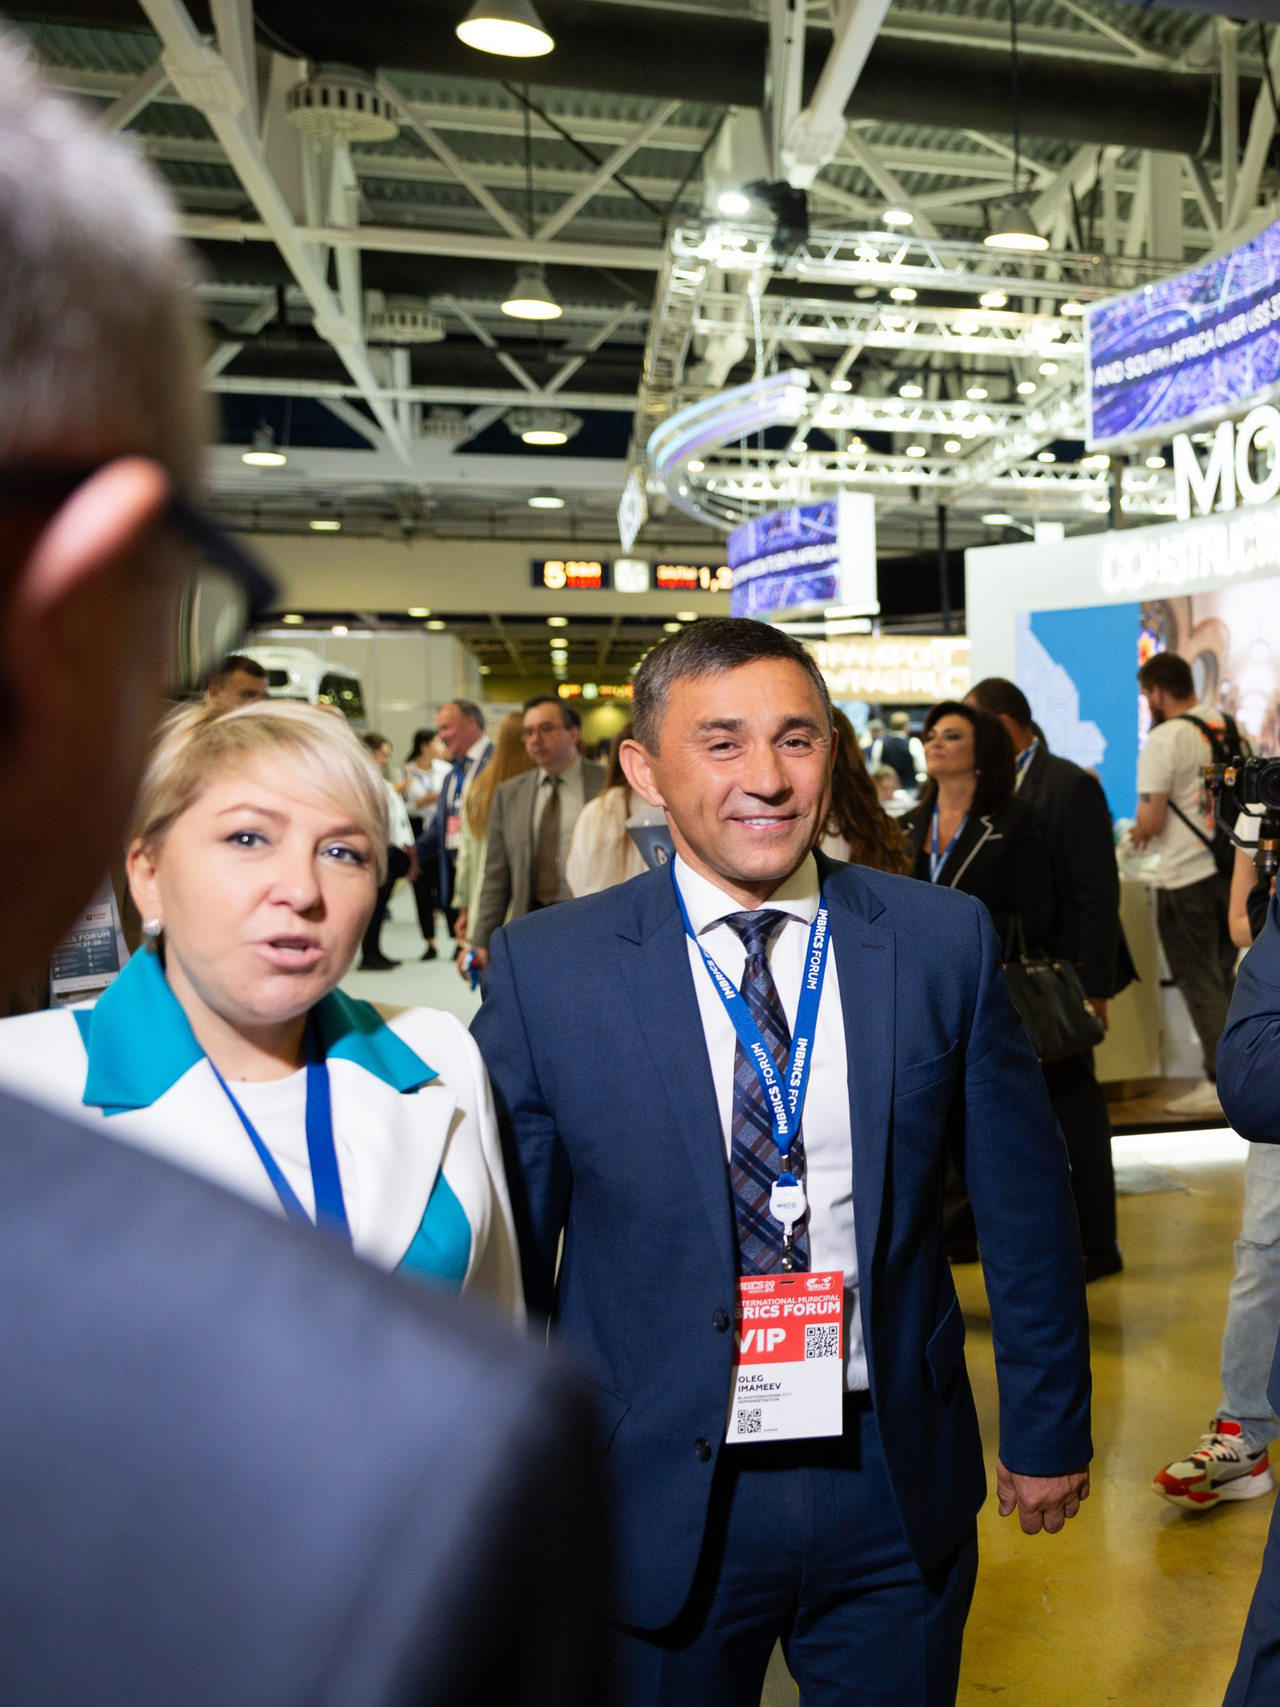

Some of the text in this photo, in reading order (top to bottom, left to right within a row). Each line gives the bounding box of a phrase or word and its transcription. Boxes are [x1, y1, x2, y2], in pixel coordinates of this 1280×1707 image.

[806, 908, 829, 990] IMBRICS FORUM
[706, 959, 737, 1000] IMBRICS
[790, 1037, 809, 1087] IMBRICS
[750, 1042, 788, 1134] IMBRICS FORUM
[783, 1301, 841, 1317] FORUM
[797, 1294, 840, 1304] MUNICIPAL
[734, 1327, 786, 1355] VIP
[738, 1375, 763, 1384] OLEG
[738, 1383, 782, 1393] IMAMEEV
